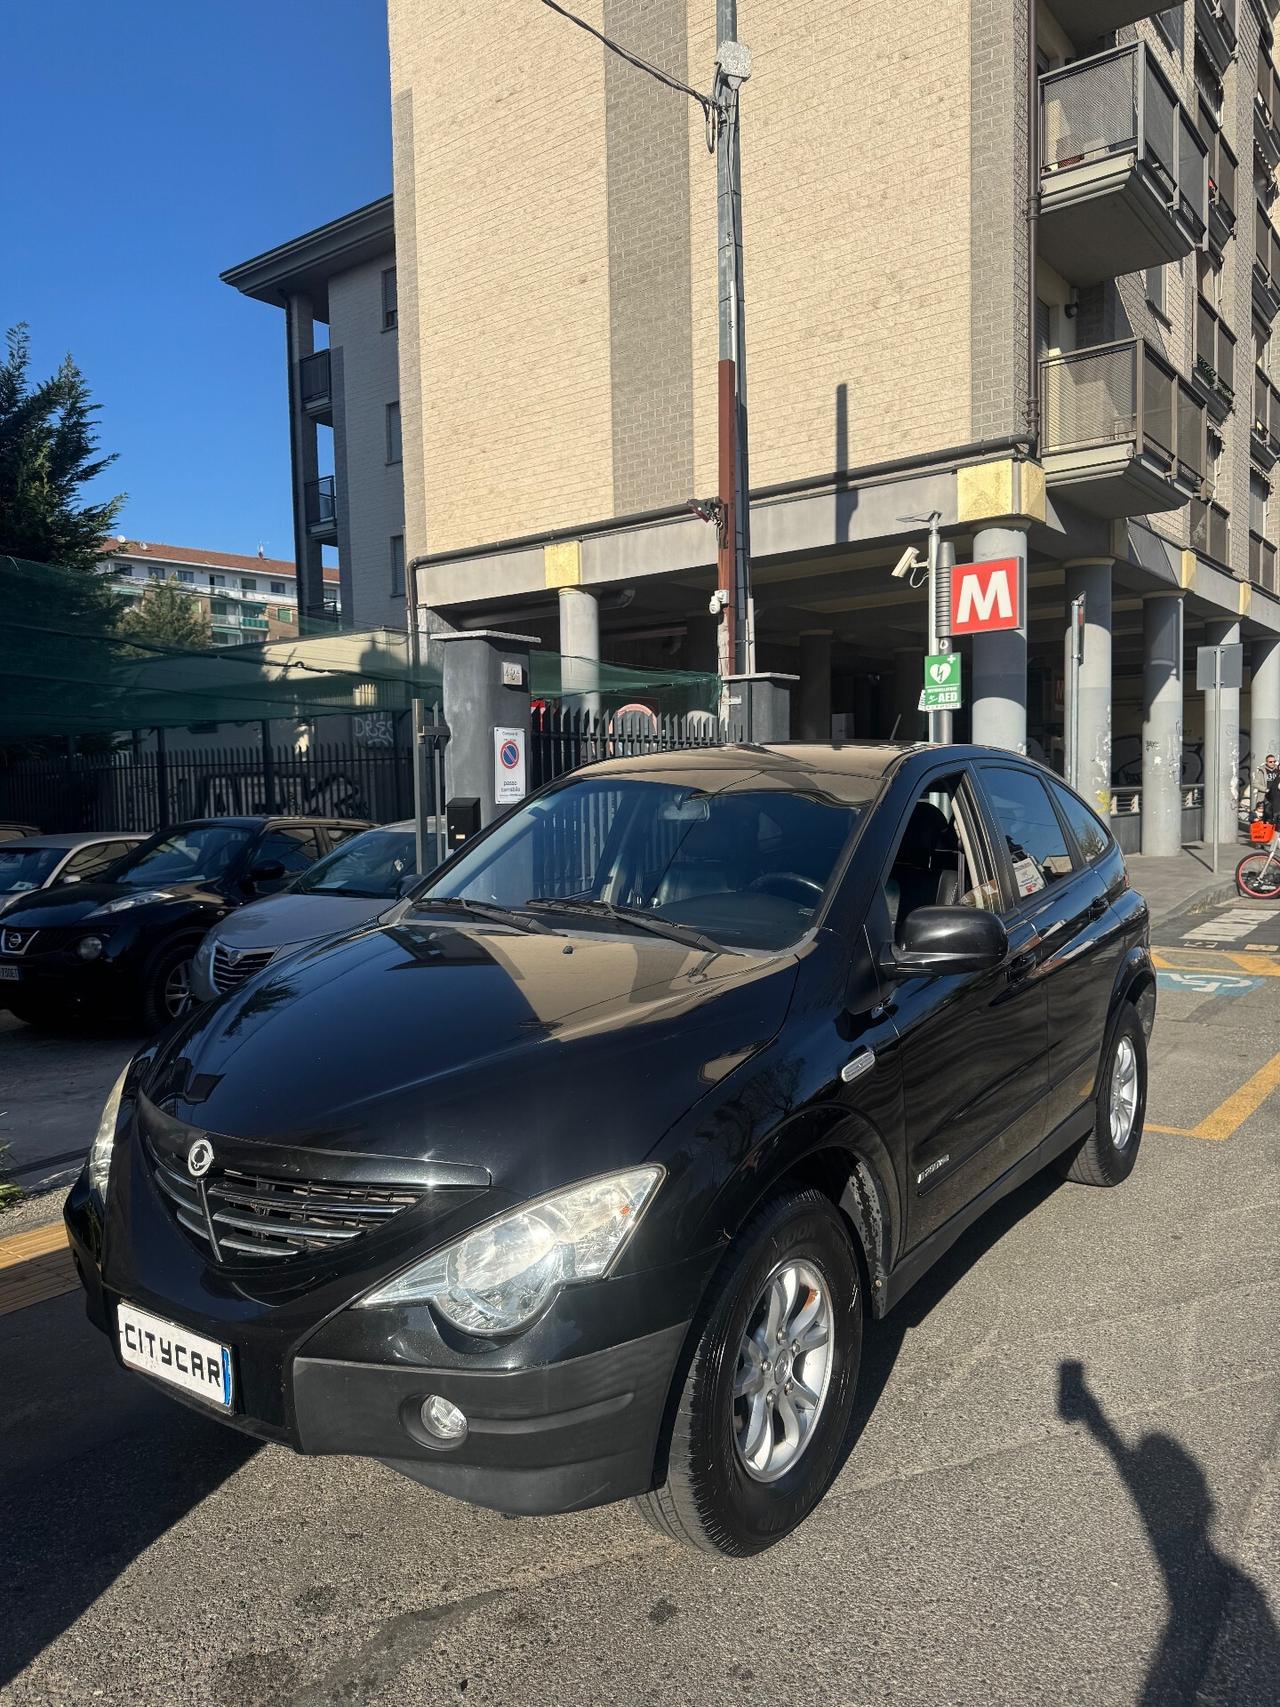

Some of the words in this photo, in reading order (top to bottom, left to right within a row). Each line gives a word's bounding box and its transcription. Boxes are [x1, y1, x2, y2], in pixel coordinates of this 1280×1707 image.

[956, 570, 1013, 624] M
[938, 692, 957, 703] AED
[125, 1322, 221, 1388] CITYCAR
